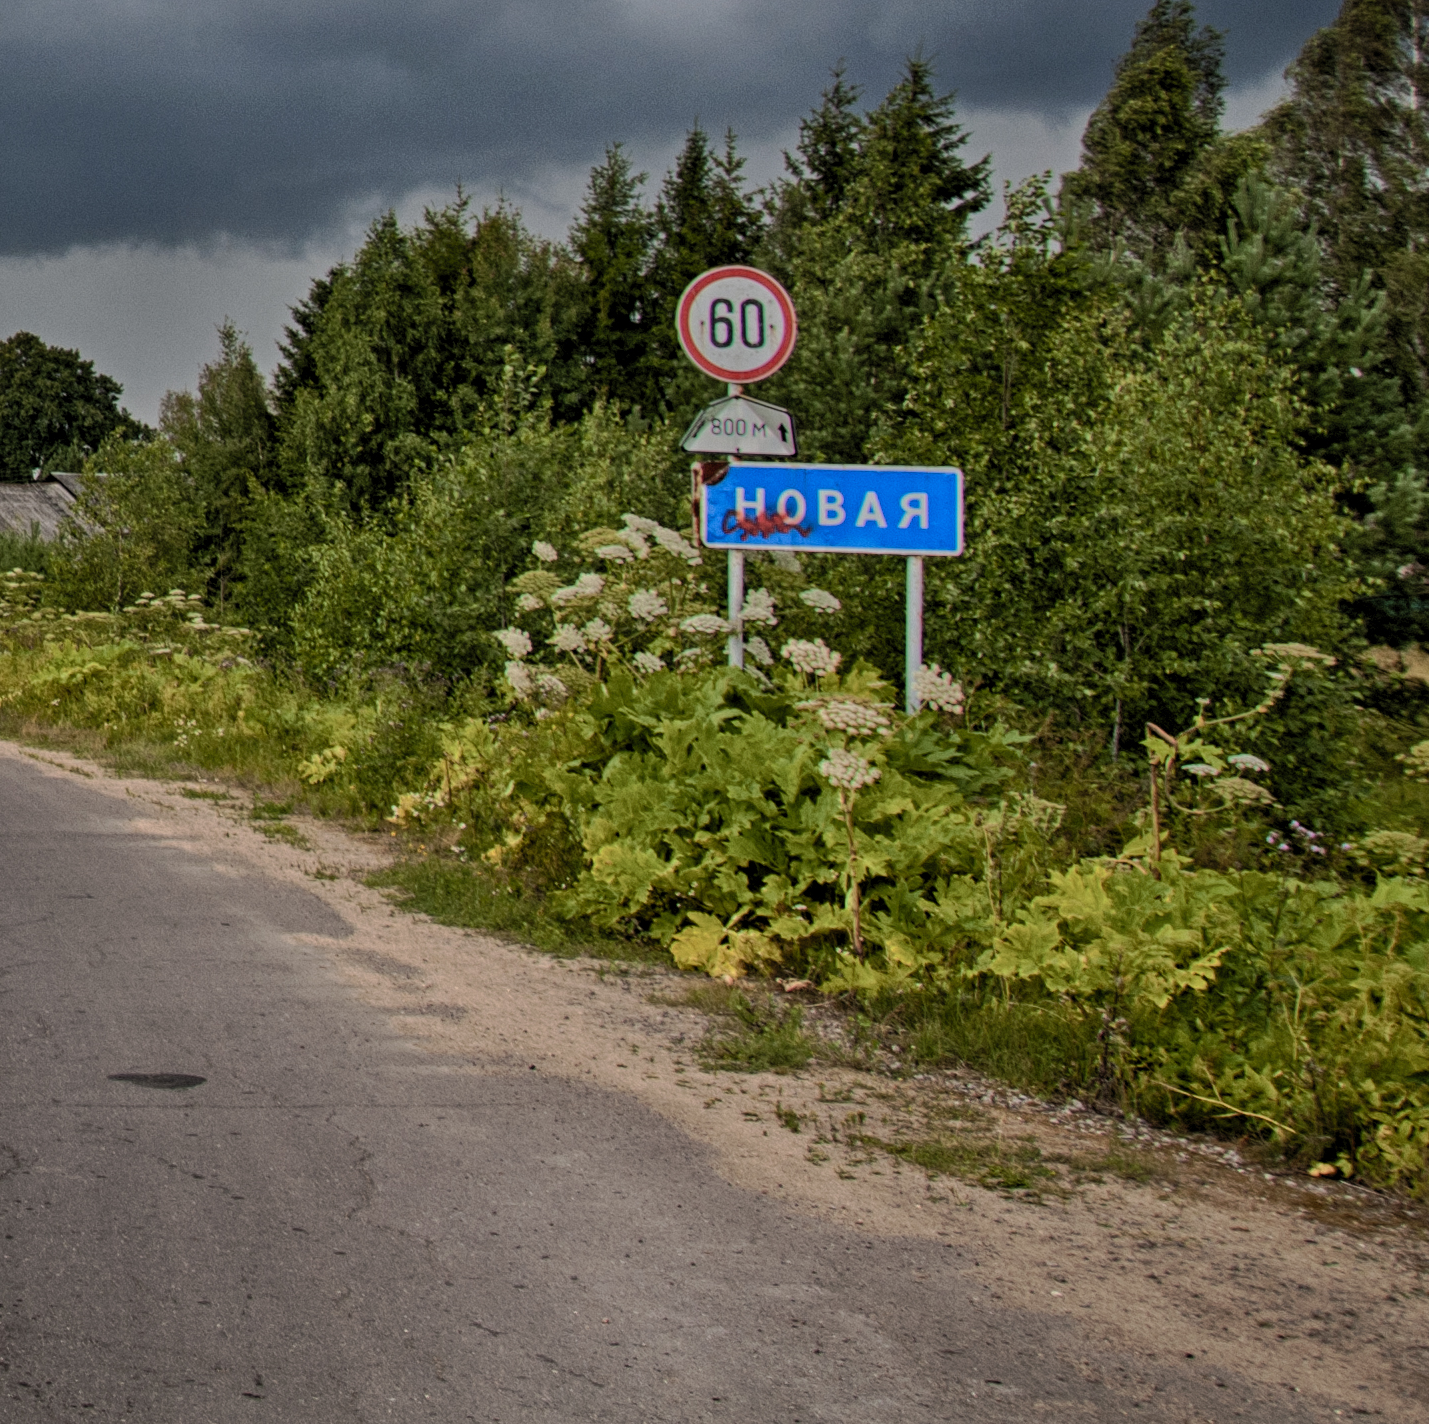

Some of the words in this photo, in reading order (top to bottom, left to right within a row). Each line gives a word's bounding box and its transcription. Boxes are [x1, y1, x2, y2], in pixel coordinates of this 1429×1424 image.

[709, 298, 765, 348] 60
[711, 418, 746, 436] 800
[734, 486, 929, 529] НОВАЯ
